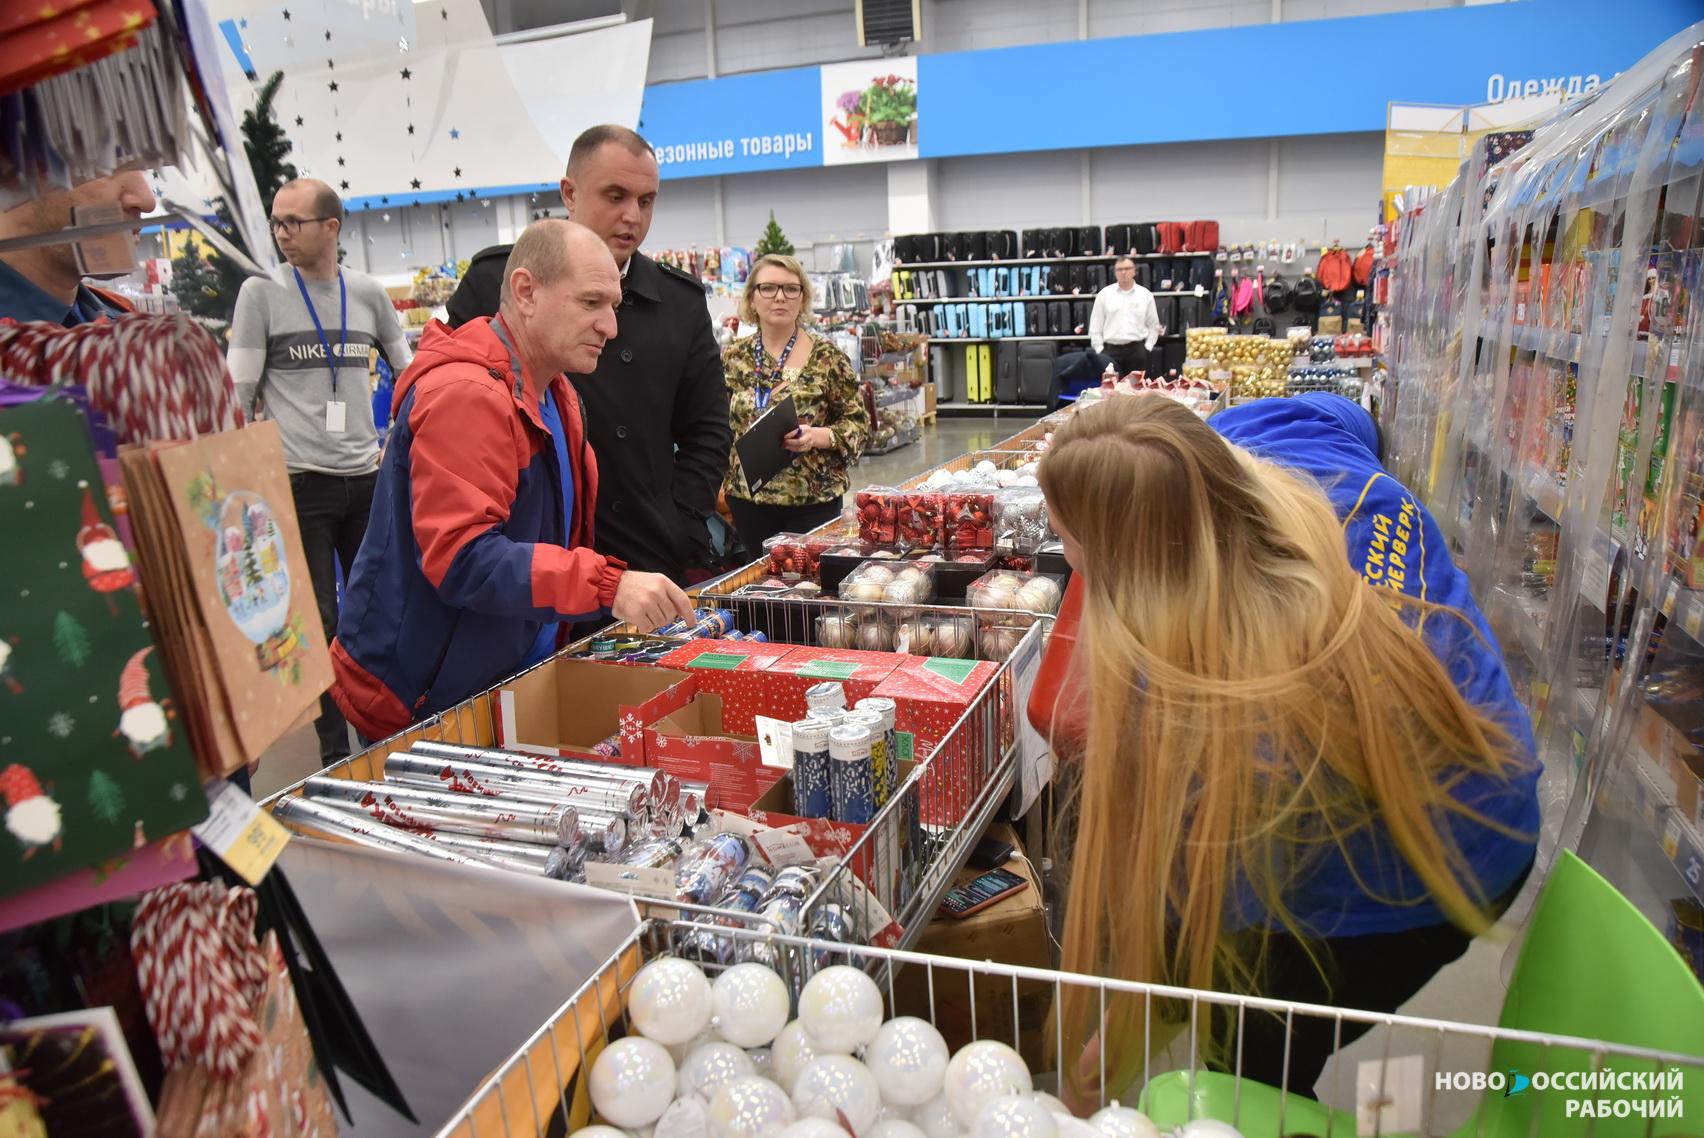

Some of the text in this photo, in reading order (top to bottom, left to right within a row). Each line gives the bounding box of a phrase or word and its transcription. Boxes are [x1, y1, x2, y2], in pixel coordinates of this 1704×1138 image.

[648, 132, 813, 166] езонные товары
[288, 343, 331, 361] NIKE
[1382, 496, 1415, 593] ЙЕРВЕРК
